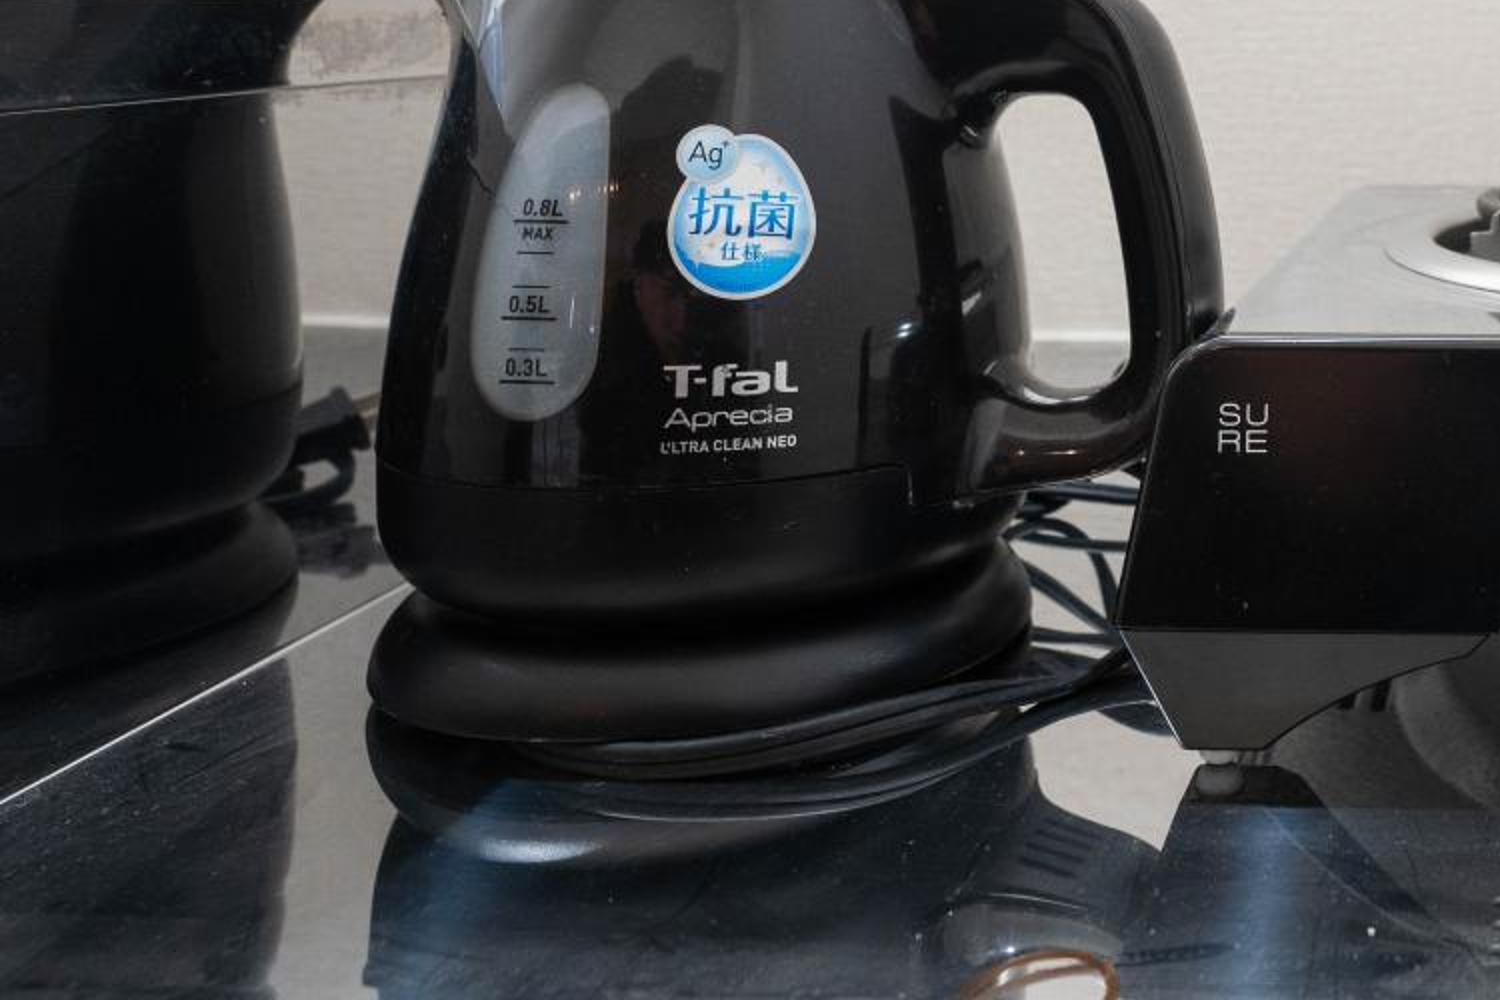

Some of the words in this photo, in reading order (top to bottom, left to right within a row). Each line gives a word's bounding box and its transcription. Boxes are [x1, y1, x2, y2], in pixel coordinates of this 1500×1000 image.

[522, 199, 564, 218] 0.8L
[688, 187, 800, 240] 抗菌
[521, 226, 554, 241] MAX
[509, 295, 550, 314] 0.5L
[505, 358, 548, 377] 0.3L
[664, 403, 793, 433] Aprecia
[713, 436, 763, 452] CLEAN
[767, 434, 797, 449] NEO
